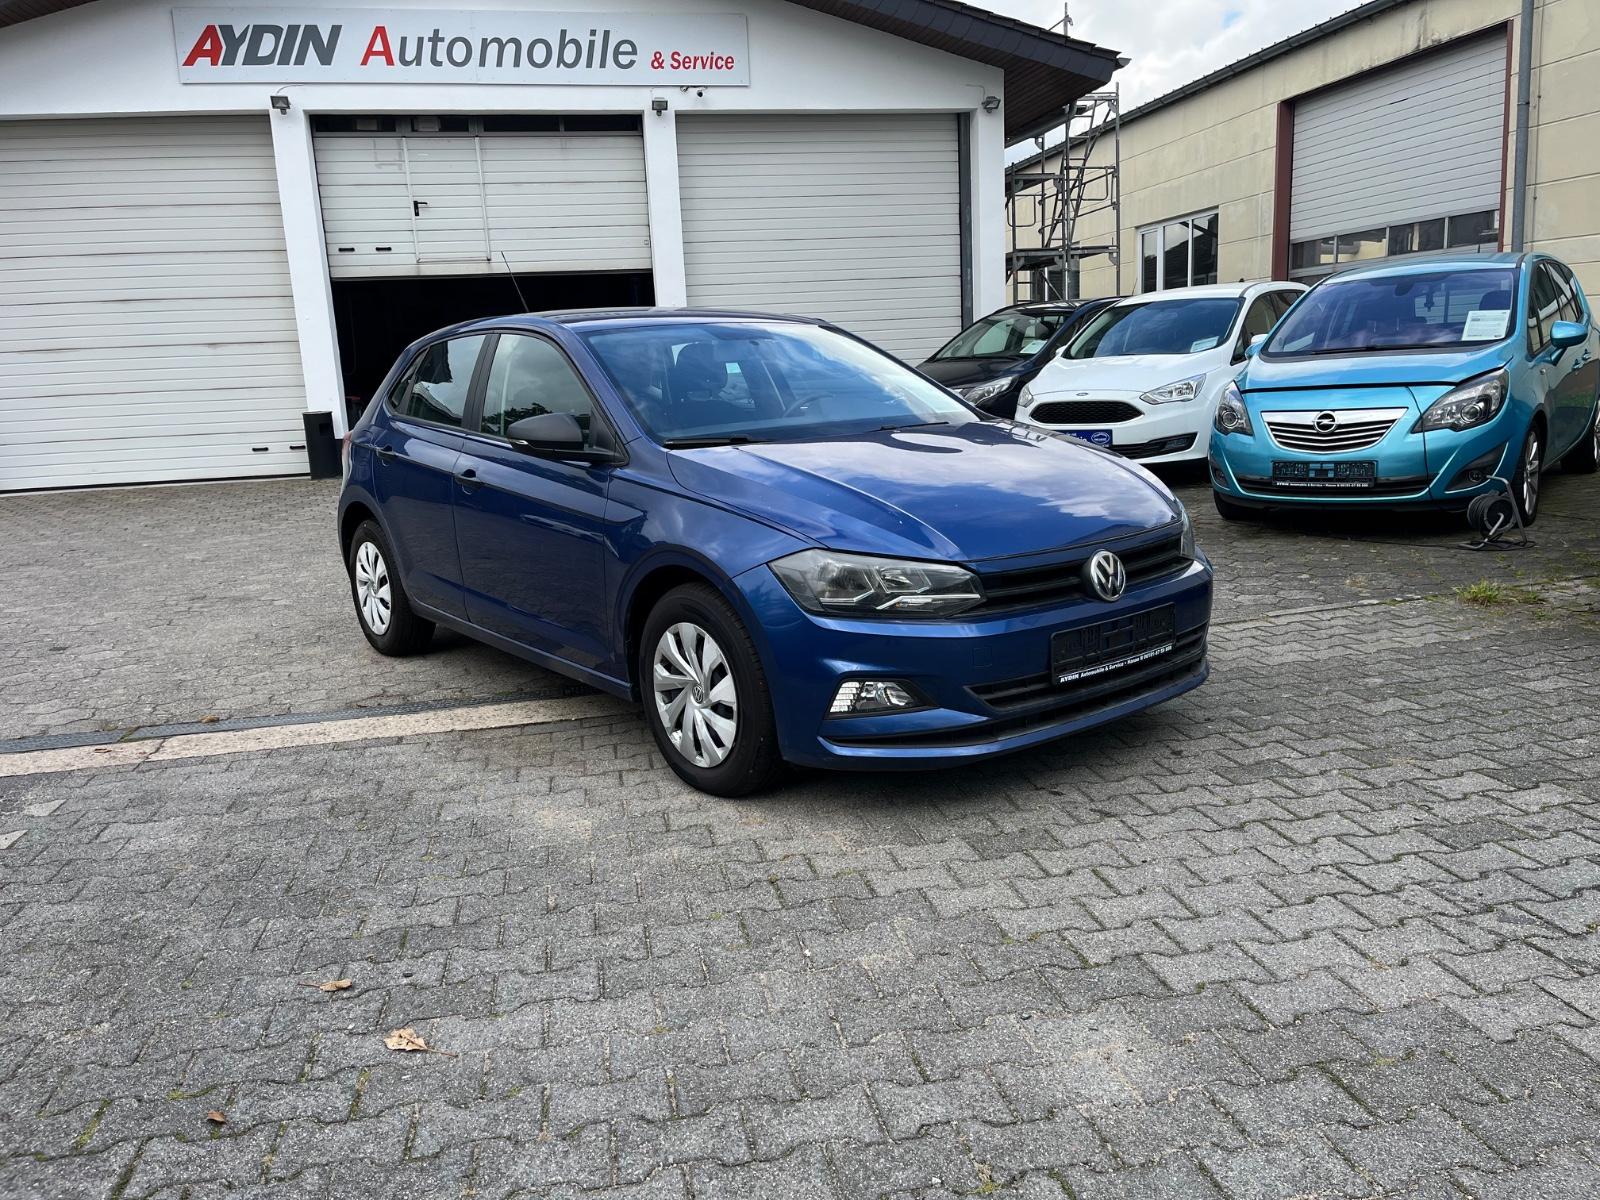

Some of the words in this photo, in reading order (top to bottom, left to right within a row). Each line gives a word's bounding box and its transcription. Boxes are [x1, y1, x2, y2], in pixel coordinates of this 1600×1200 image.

[182, 24, 343, 66] AYDIN
[360, 25, 638, 69] Automobile
[650, 51, 665, 70] &
[670, 51, 735, 70] Service
[1060, 673, 1079, 683] AYDIN
